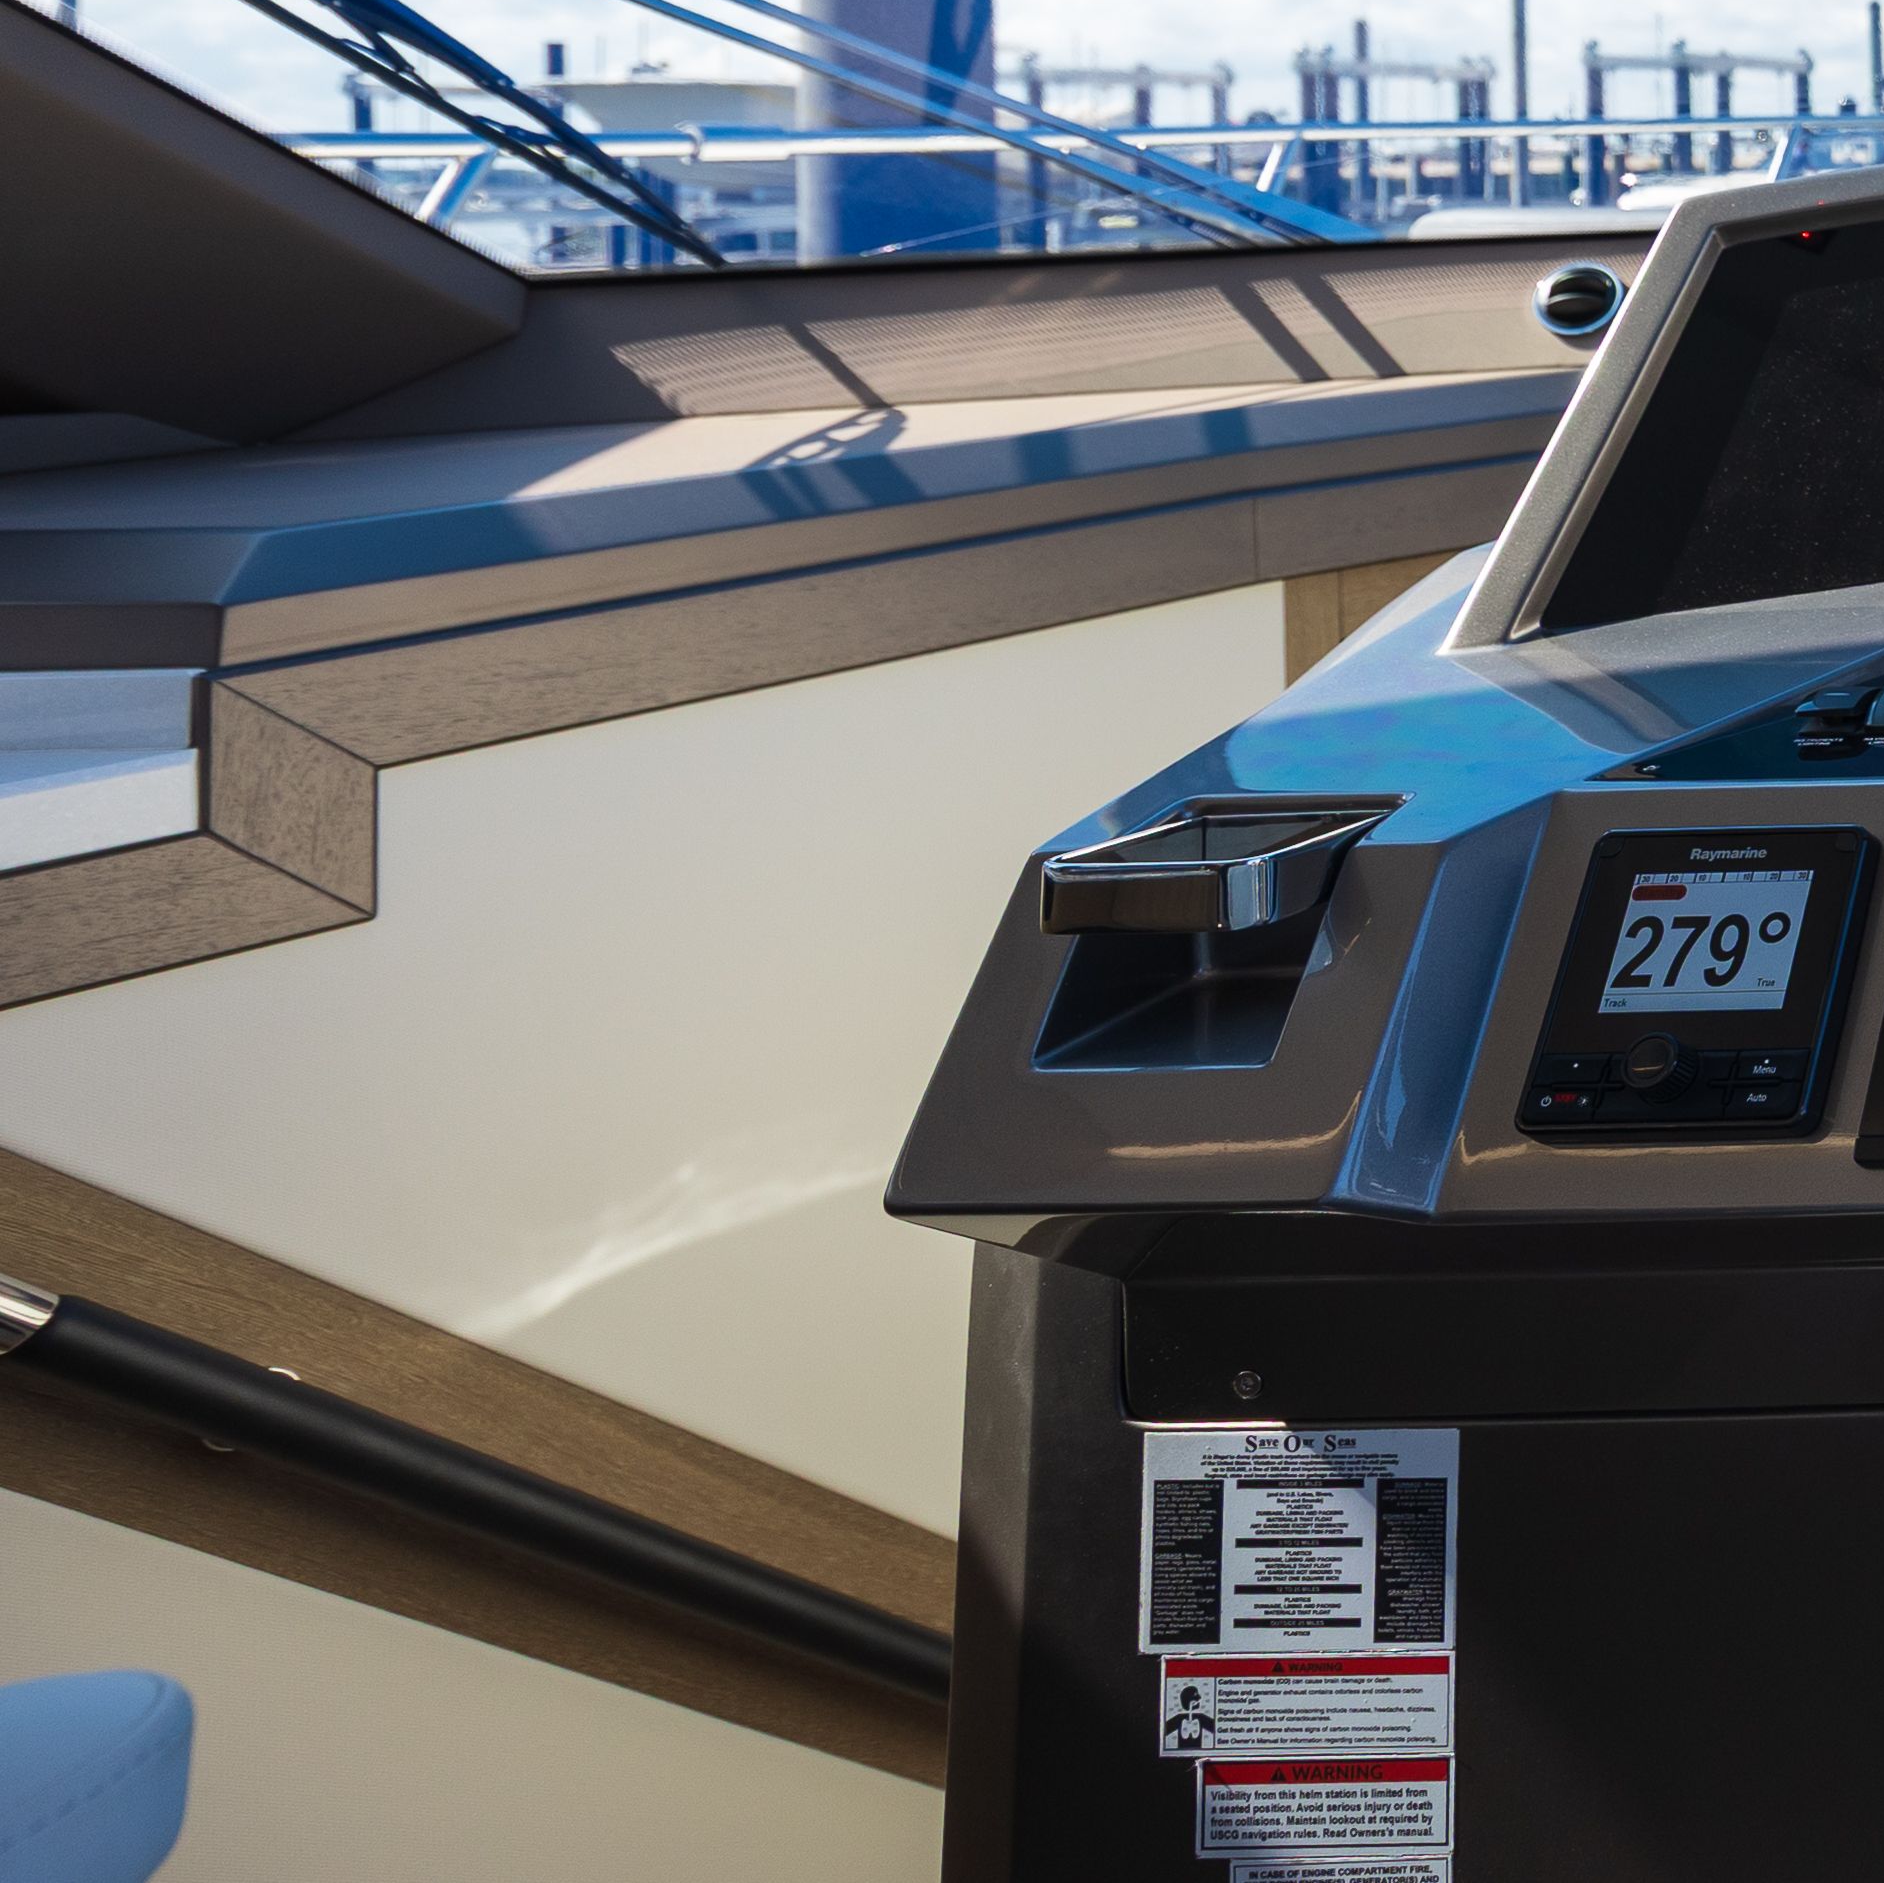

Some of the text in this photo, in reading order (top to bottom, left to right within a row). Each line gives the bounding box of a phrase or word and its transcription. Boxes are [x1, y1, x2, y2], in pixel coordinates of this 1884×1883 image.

[1690, 846, 1768, 862] Raymarine
[1610, 911, 1792, 989] 279°
[1756, 977, 1776, 988] True
[1603, 997, 1628, 1008] Track
[1752, 1064, 1777, 1075] Menu
[1746, 1092, 1767, 1103] Auto
[1245, 1434, 1357, 1453] Save Our Seas
[1290, 1662, 1344, 1672] WARNING
[1218, 1689, 1239, 1697] Engine
[1322, 1737, 1353, 1745] regarding
[1291, 1764, 1383, 1781] WARNING
[1211, 1787, 1429, 1803] Visibility from this helm station is limited from
[1211, 1806, 1217, 1814] a
[1219, 1804, 1251, 1814] seated
[1296, 1802, 1324, 1813] Avoid
[1326, 1802, 1361, 1812] serious
[1364, 1801, 1392, 1814] injury
[1394, 1803, 1405, 1811] or
[1406, 1801, 1433, 1811] death
[1211, 1817, 1233, 1827] from
[1286, 1815, 1327, 1826] Maintain
[1330, 1815, 1366, 1825] lookout
[1368, 1815, 1377, 1825] at
[1380, 1814, 1419, 1826] required
[1421, 1814, 1434, 1826] by
[1211, 1829, 1240, 1841] USCG
[1242, 1829, 1292, 1842] navigation
[1322, 1828, 1347, 1838] Read
[1349, 1827, 1394, 1838] Owners's
[1397, 1826, 1435, 1837] manual.
[1249, 1871, 1259, 1879] IN
[1260, 1870, 1286, 1879] CASE
[1286, 1869, 1300, 1878] OF
[1302, 1868, 1336, 1877] ENGINE
[1339, 1866, 1408, 1876] COMPARTMENT
[1420, 1875, 1440, 1883] AND
